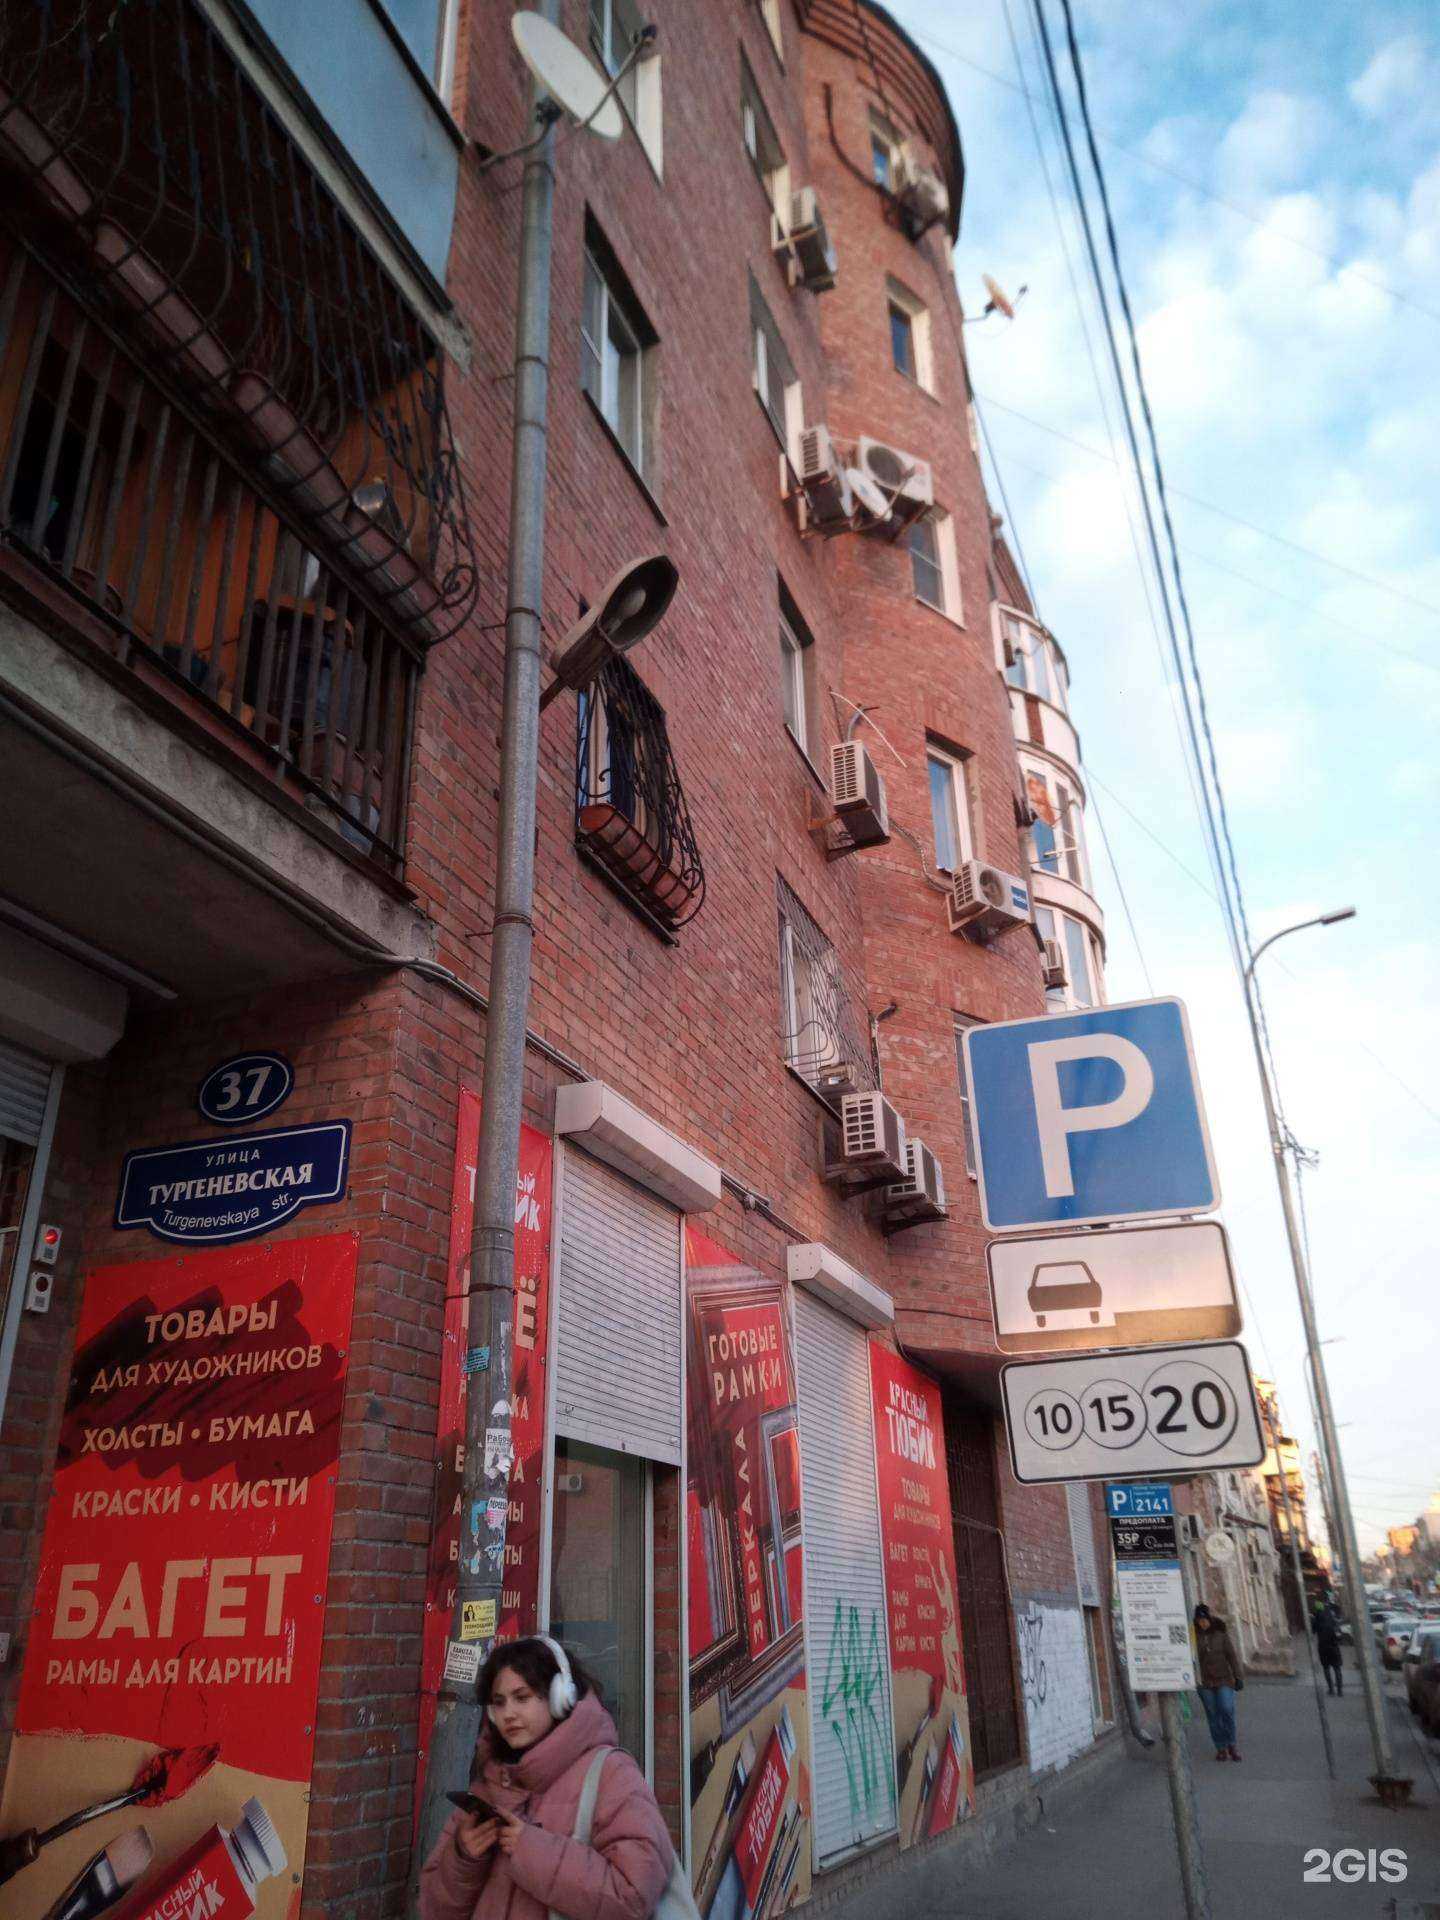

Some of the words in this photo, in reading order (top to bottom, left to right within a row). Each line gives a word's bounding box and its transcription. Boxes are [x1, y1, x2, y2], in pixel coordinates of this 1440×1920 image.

[216, 1066, 272, 1111] 37
[1028, 1033, 1154, 1199] P
[206, 1149, 261, 1167] УЛИЦА
[149, 1163, 313, 1205] ТУРГЕНЕВСКАЯ
[163, 1207, 260, 1231] Turgenevskaya
[271, 1193, 293, 1210] str.
[144, 1299, 279, 1344] ТОВАРЫ
[708, 1325, 778, 1363] ГОТОВЫЕ
[90, 1364, 139, 1394] ДЛЯ
[146, 1344, 322, 1387] ХУДОЖНИКОВ
[713, 1358, 782, 1405] РАМКИ
[1033, 1403, 1072, 1435] 10
[1089, 1395, 1134, 1432] 15
[1151, 1381, 1226, 1434] 20
[81, 1421, 184, 1453] ХОЛСТЫ
[208, 1409, 316, 1443] БУМАГА
[884, 1405, 936, 1470] ТЮБИК
[72, 1484, 183, 1519] КРАСКИ
[209, 1476, 309, 1511] КИСТИ
[1112, 1490, 1127, 1511] P
[1136, 1498, 1169, 1512] 2141
[734, 1426, 765, 1644] ЗЕРКАЛА
[52, 1554, 303, 1639] БАГЕТ
[47, 1658, 119, 1685] РАМЫ
[125, 1658, 181, 1688] ДЛЯ
[188, 1657, 293, 1685] КАРТИН
